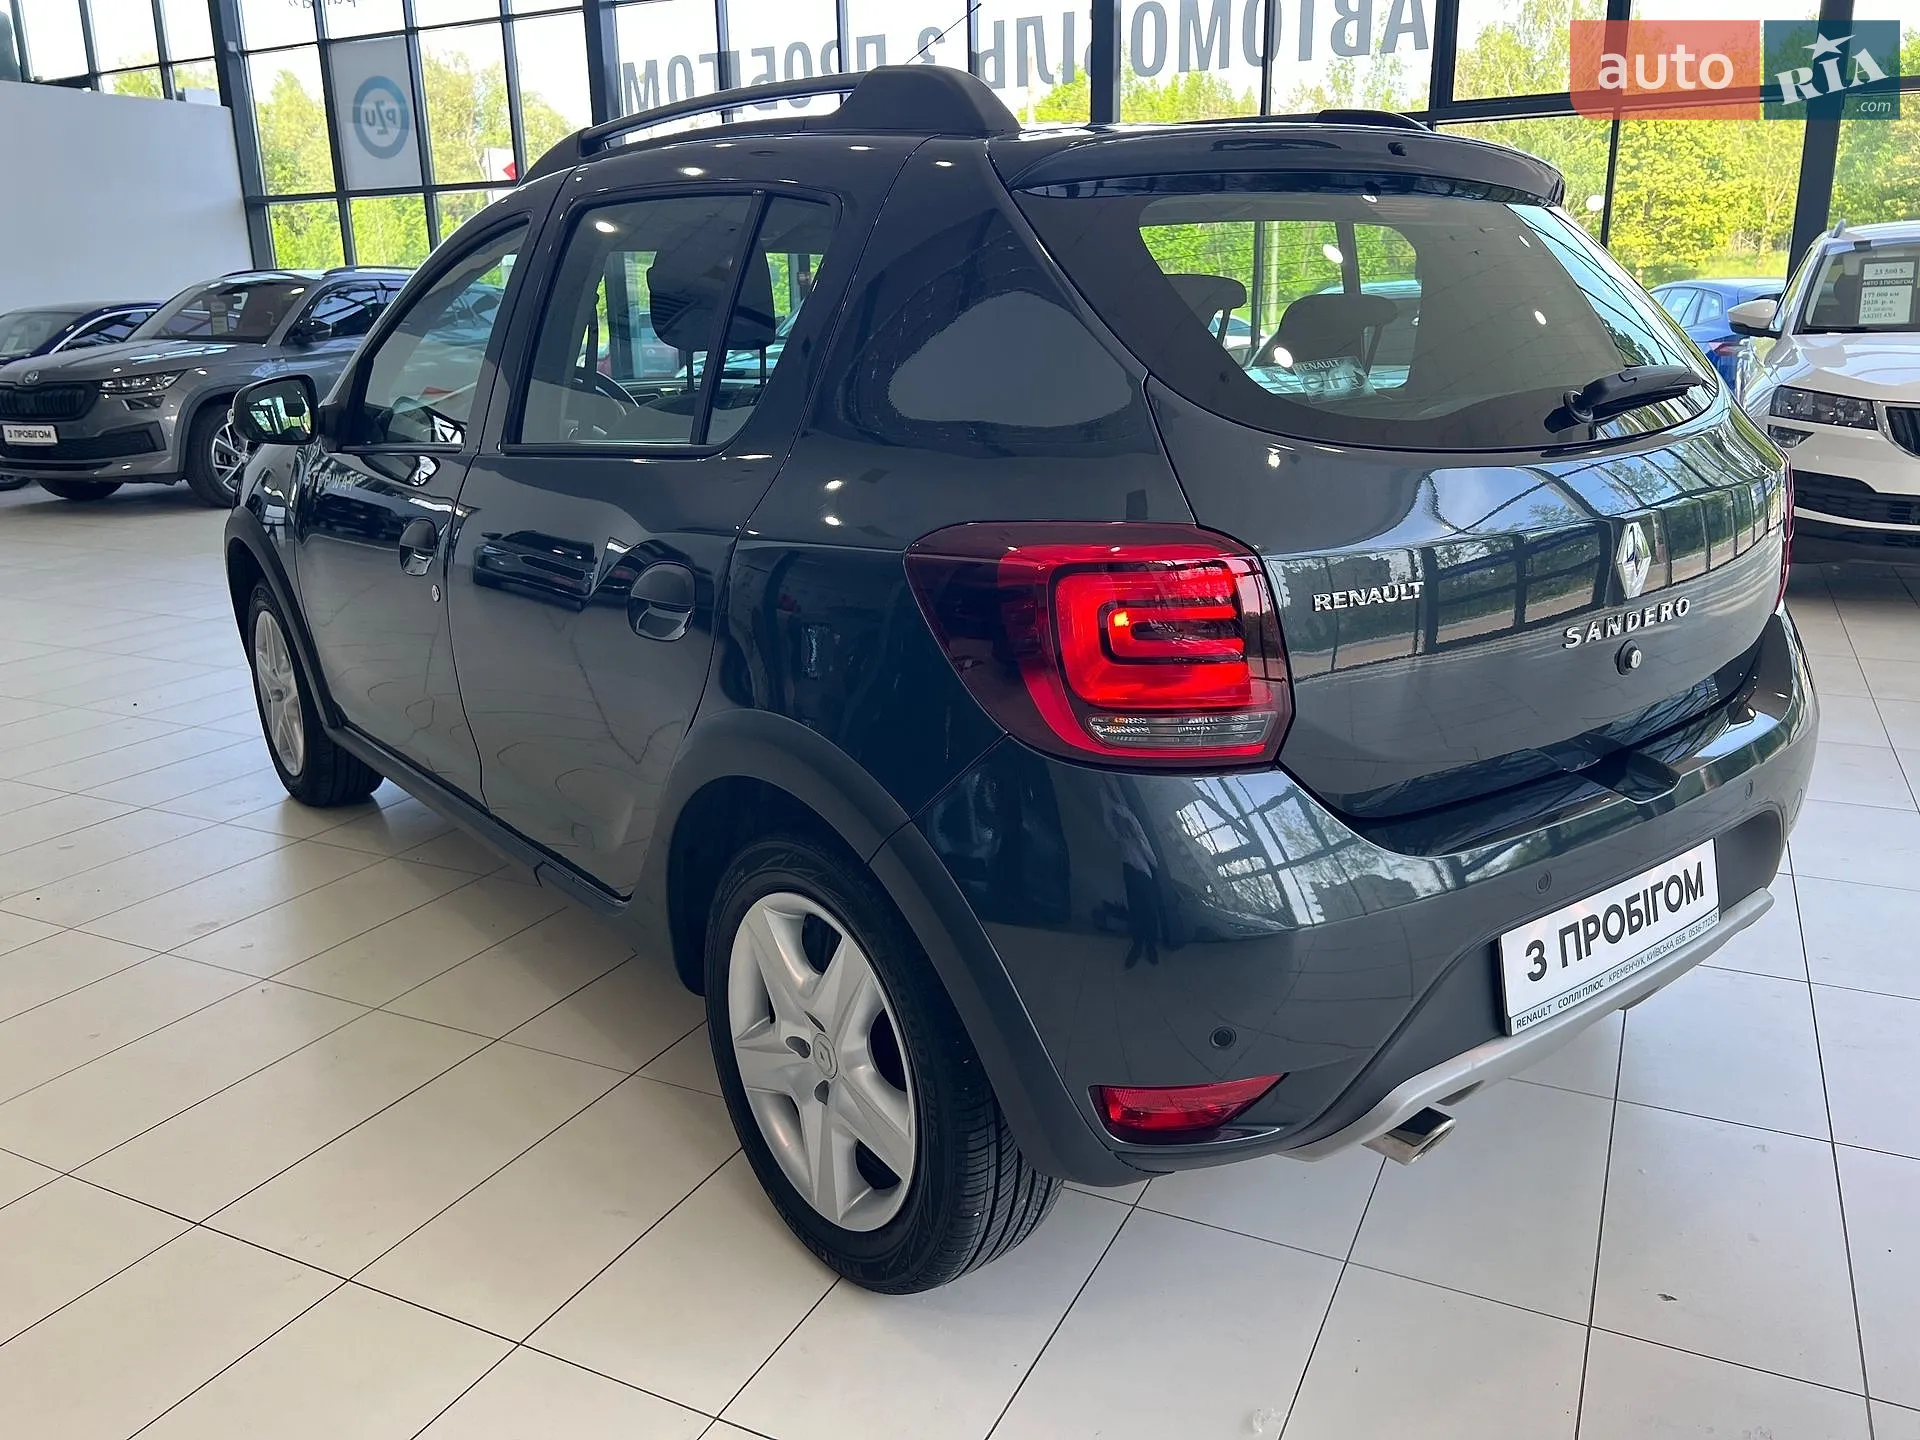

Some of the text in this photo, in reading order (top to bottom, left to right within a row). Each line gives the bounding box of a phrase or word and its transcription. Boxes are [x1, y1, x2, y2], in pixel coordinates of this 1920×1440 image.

[1312, 581, 1424, 612] RENAULT
[1562, 597, 1692, 649] SANDERO
[1525, 861, 1705, 982] З ПРОБІГОМ
[1516, 1003, 1552, 1029] RENAULT
[1582, 978, 1604, 997] ПЛЮС
[1608, 958, 1646, 982] КРЕМЕНЧУК
